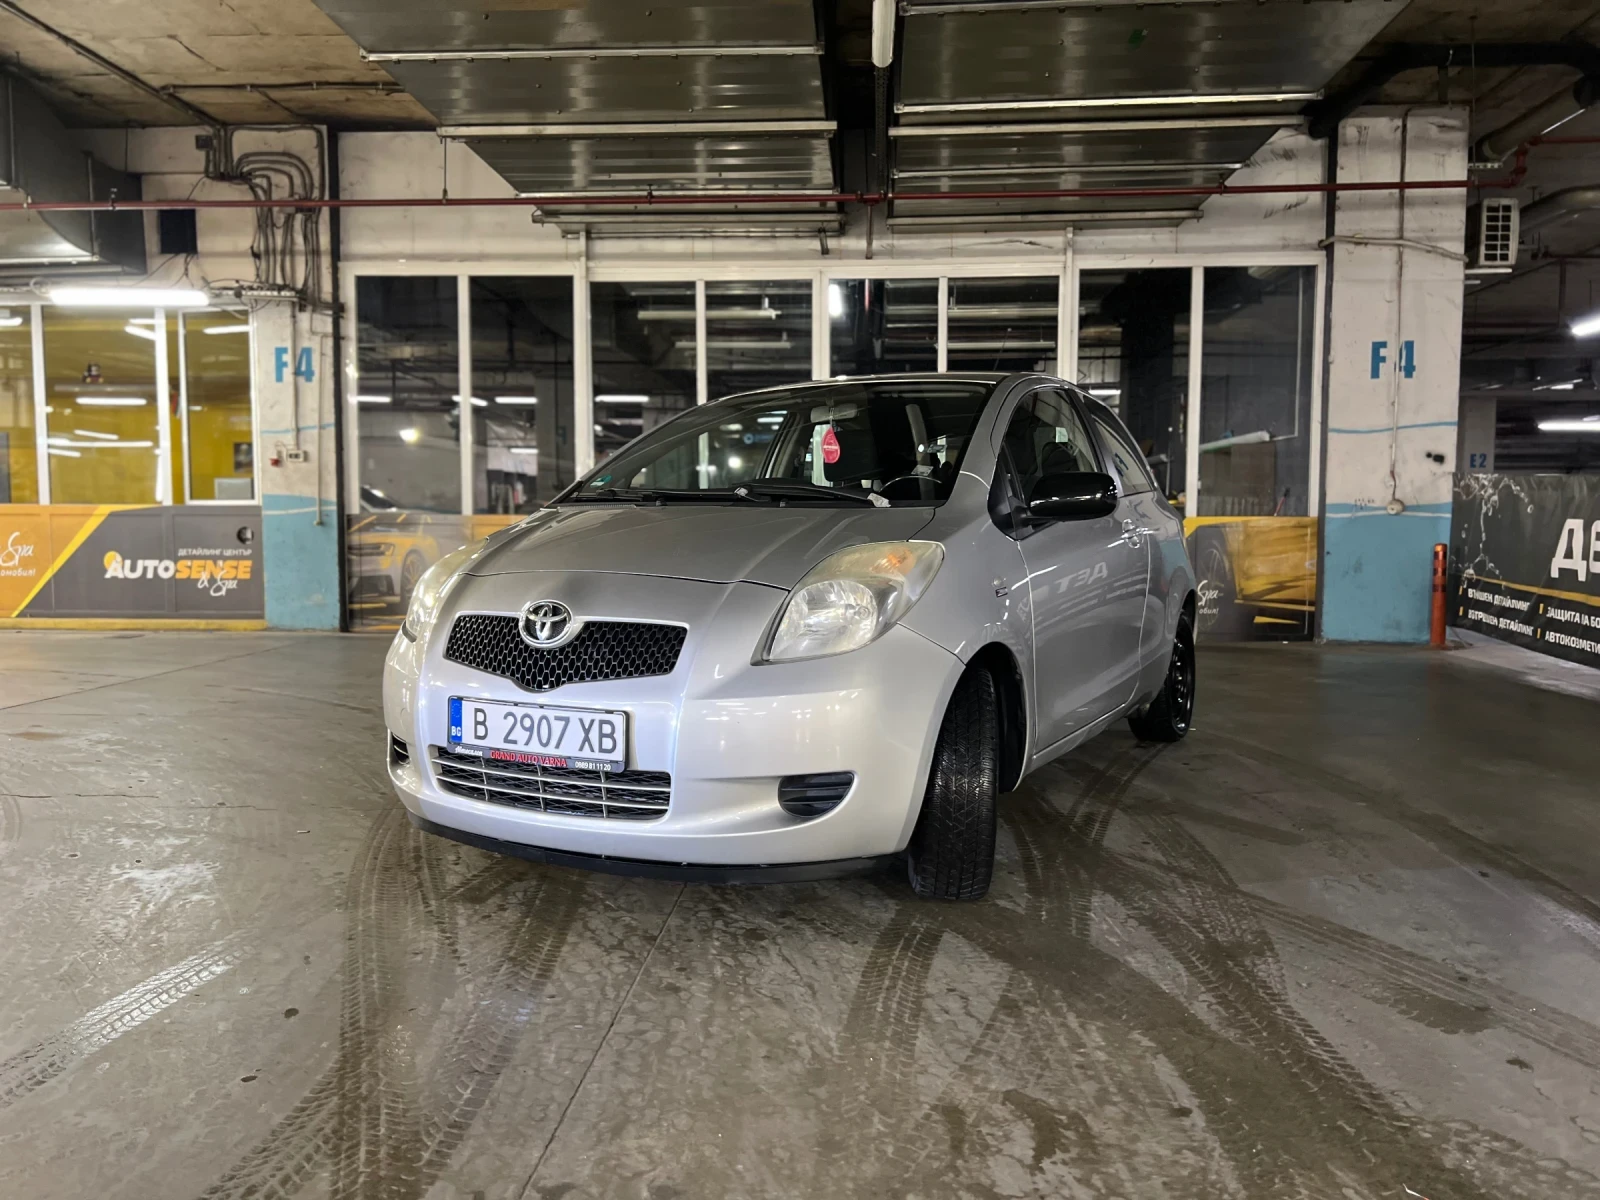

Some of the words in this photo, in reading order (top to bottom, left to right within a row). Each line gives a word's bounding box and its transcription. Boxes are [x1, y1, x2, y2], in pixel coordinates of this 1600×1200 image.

[274, 346, 315, 383] F4
[1469, 453, 1487, 468] E2
[178, 547, 222, 557] ДЕТАЙЛИНГ
[223, 548, 252, 557] ЦЕНТЪР
[104, 559, 252, 580] AUTOSENSE
[1546, 606, 1580, 624] ЗАЩИТА
[451, 725, 461, 737] BG
[473, 707, 488, 741] B
[503, 711, 570, 750] 2907
[578, 717, 617, 754] XB
[490, 750, 515, 762] GRAND
[517, 753, 538, 765] AUTO
[539, 755, 567, 768] VARNA
